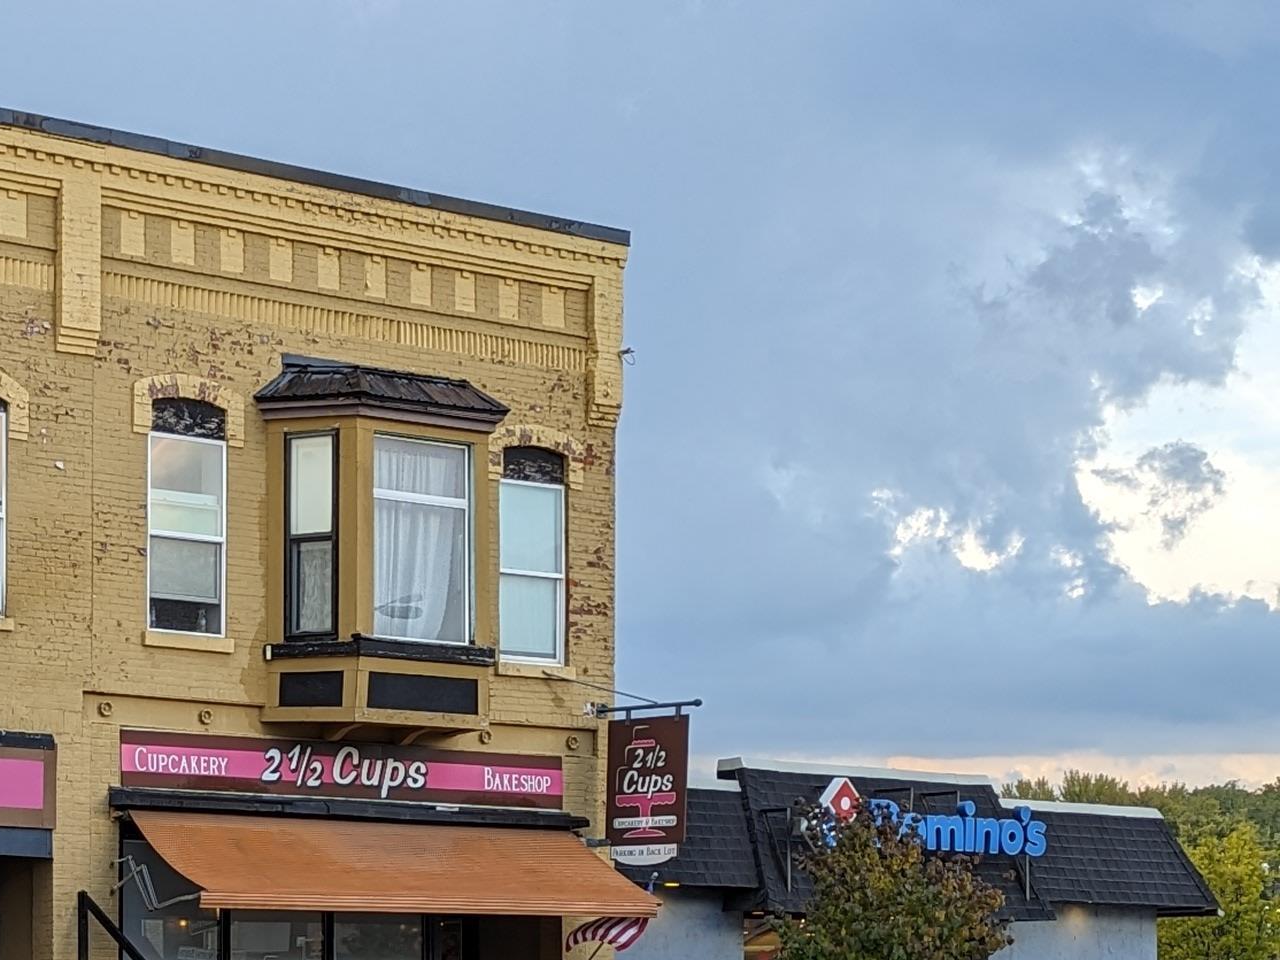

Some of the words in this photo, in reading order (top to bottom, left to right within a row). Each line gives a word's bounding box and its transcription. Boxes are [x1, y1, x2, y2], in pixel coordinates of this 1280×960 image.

[134, 746, 229, 776] CUPCAKERY
[332, 745, 428, 799] Cups
[483, 766, 552, 794] BAKESHOP
[623, 770, 674, 799] Cups
